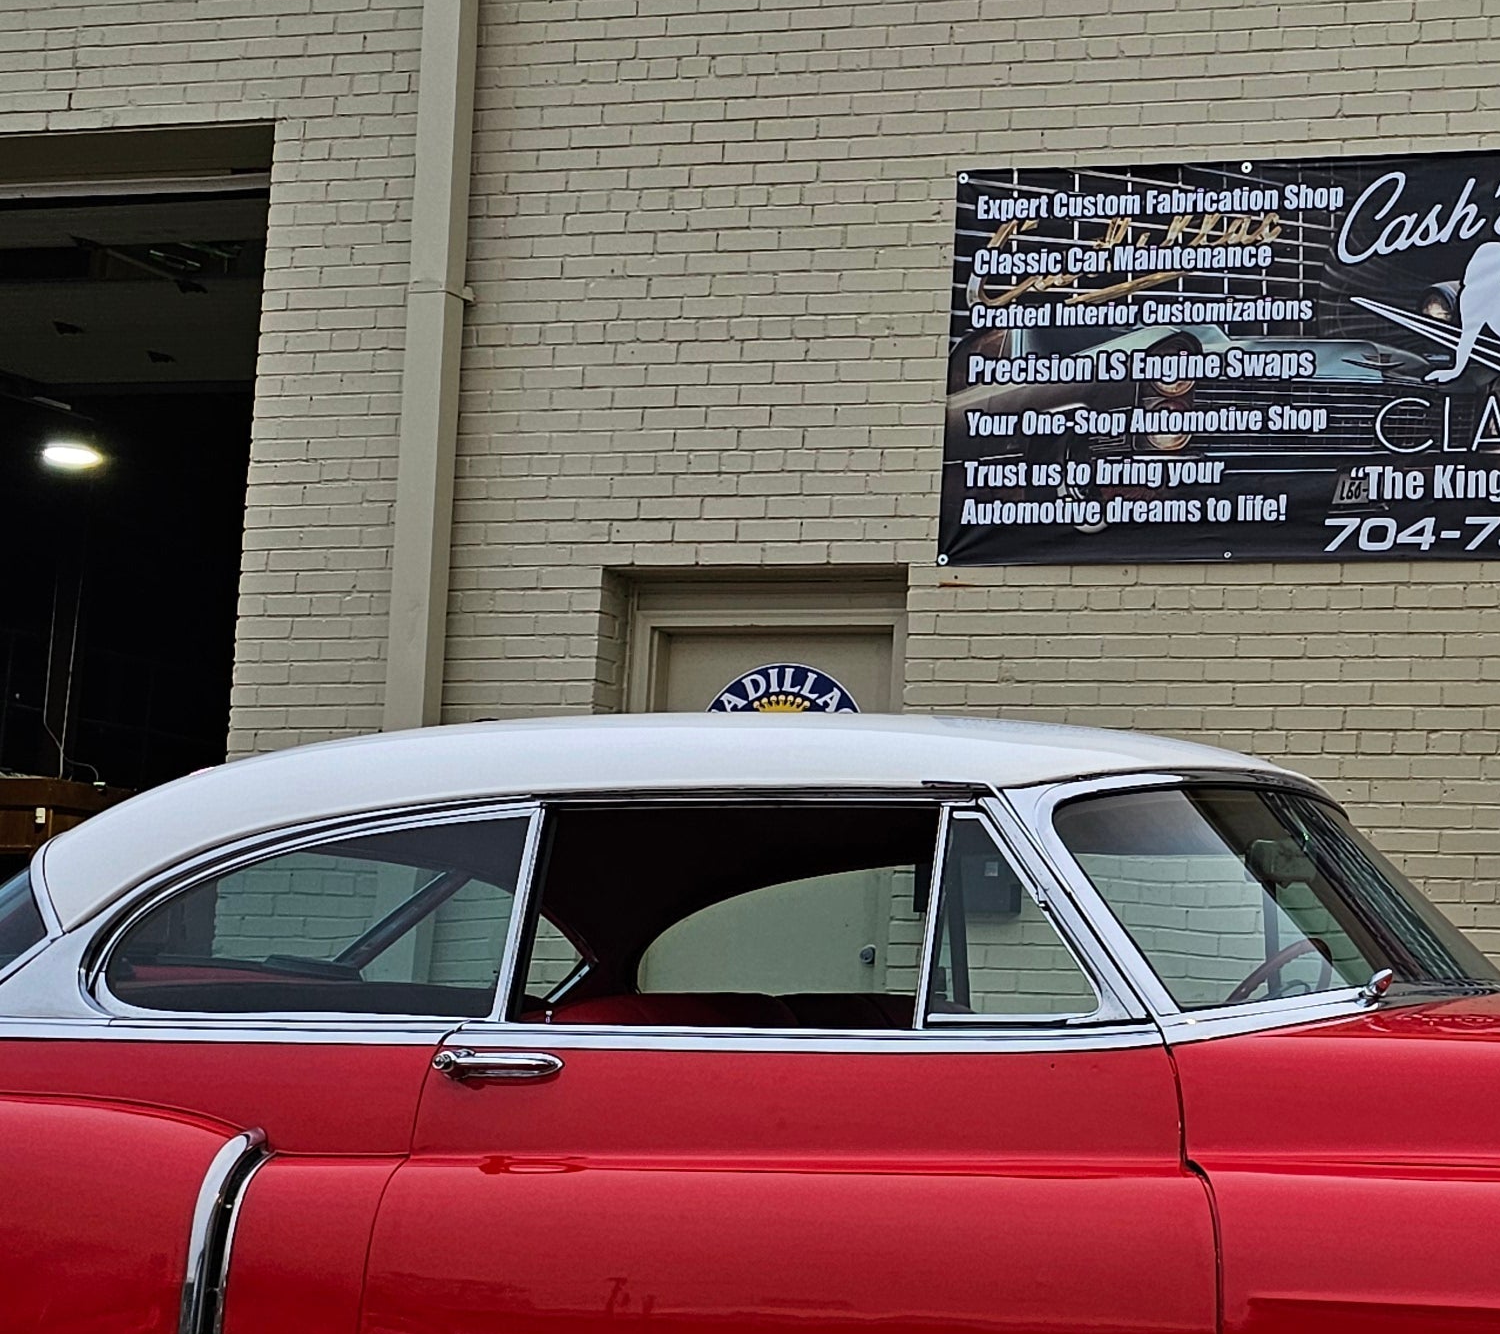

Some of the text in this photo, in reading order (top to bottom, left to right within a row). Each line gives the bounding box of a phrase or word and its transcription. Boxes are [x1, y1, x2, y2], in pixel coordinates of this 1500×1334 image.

[977, 186, 1344, 220] Expert Custom Fabrication Shop
[974, 245, 1272, 275] Classic Car Maintenance
[972, 298, 1313, 328] Crafted Interior Customizations
[968, 349, 1314, 383] Precision LS Engine Swaps
[967, 406, 1328, 436] Your One-Stop Automotive Shop
[965, 460, 1225, 487] Trust us to bring your
[961, 494, 1287, 525] Automotive dreams to life!
[710, 668, 855, 713] ADILLA
